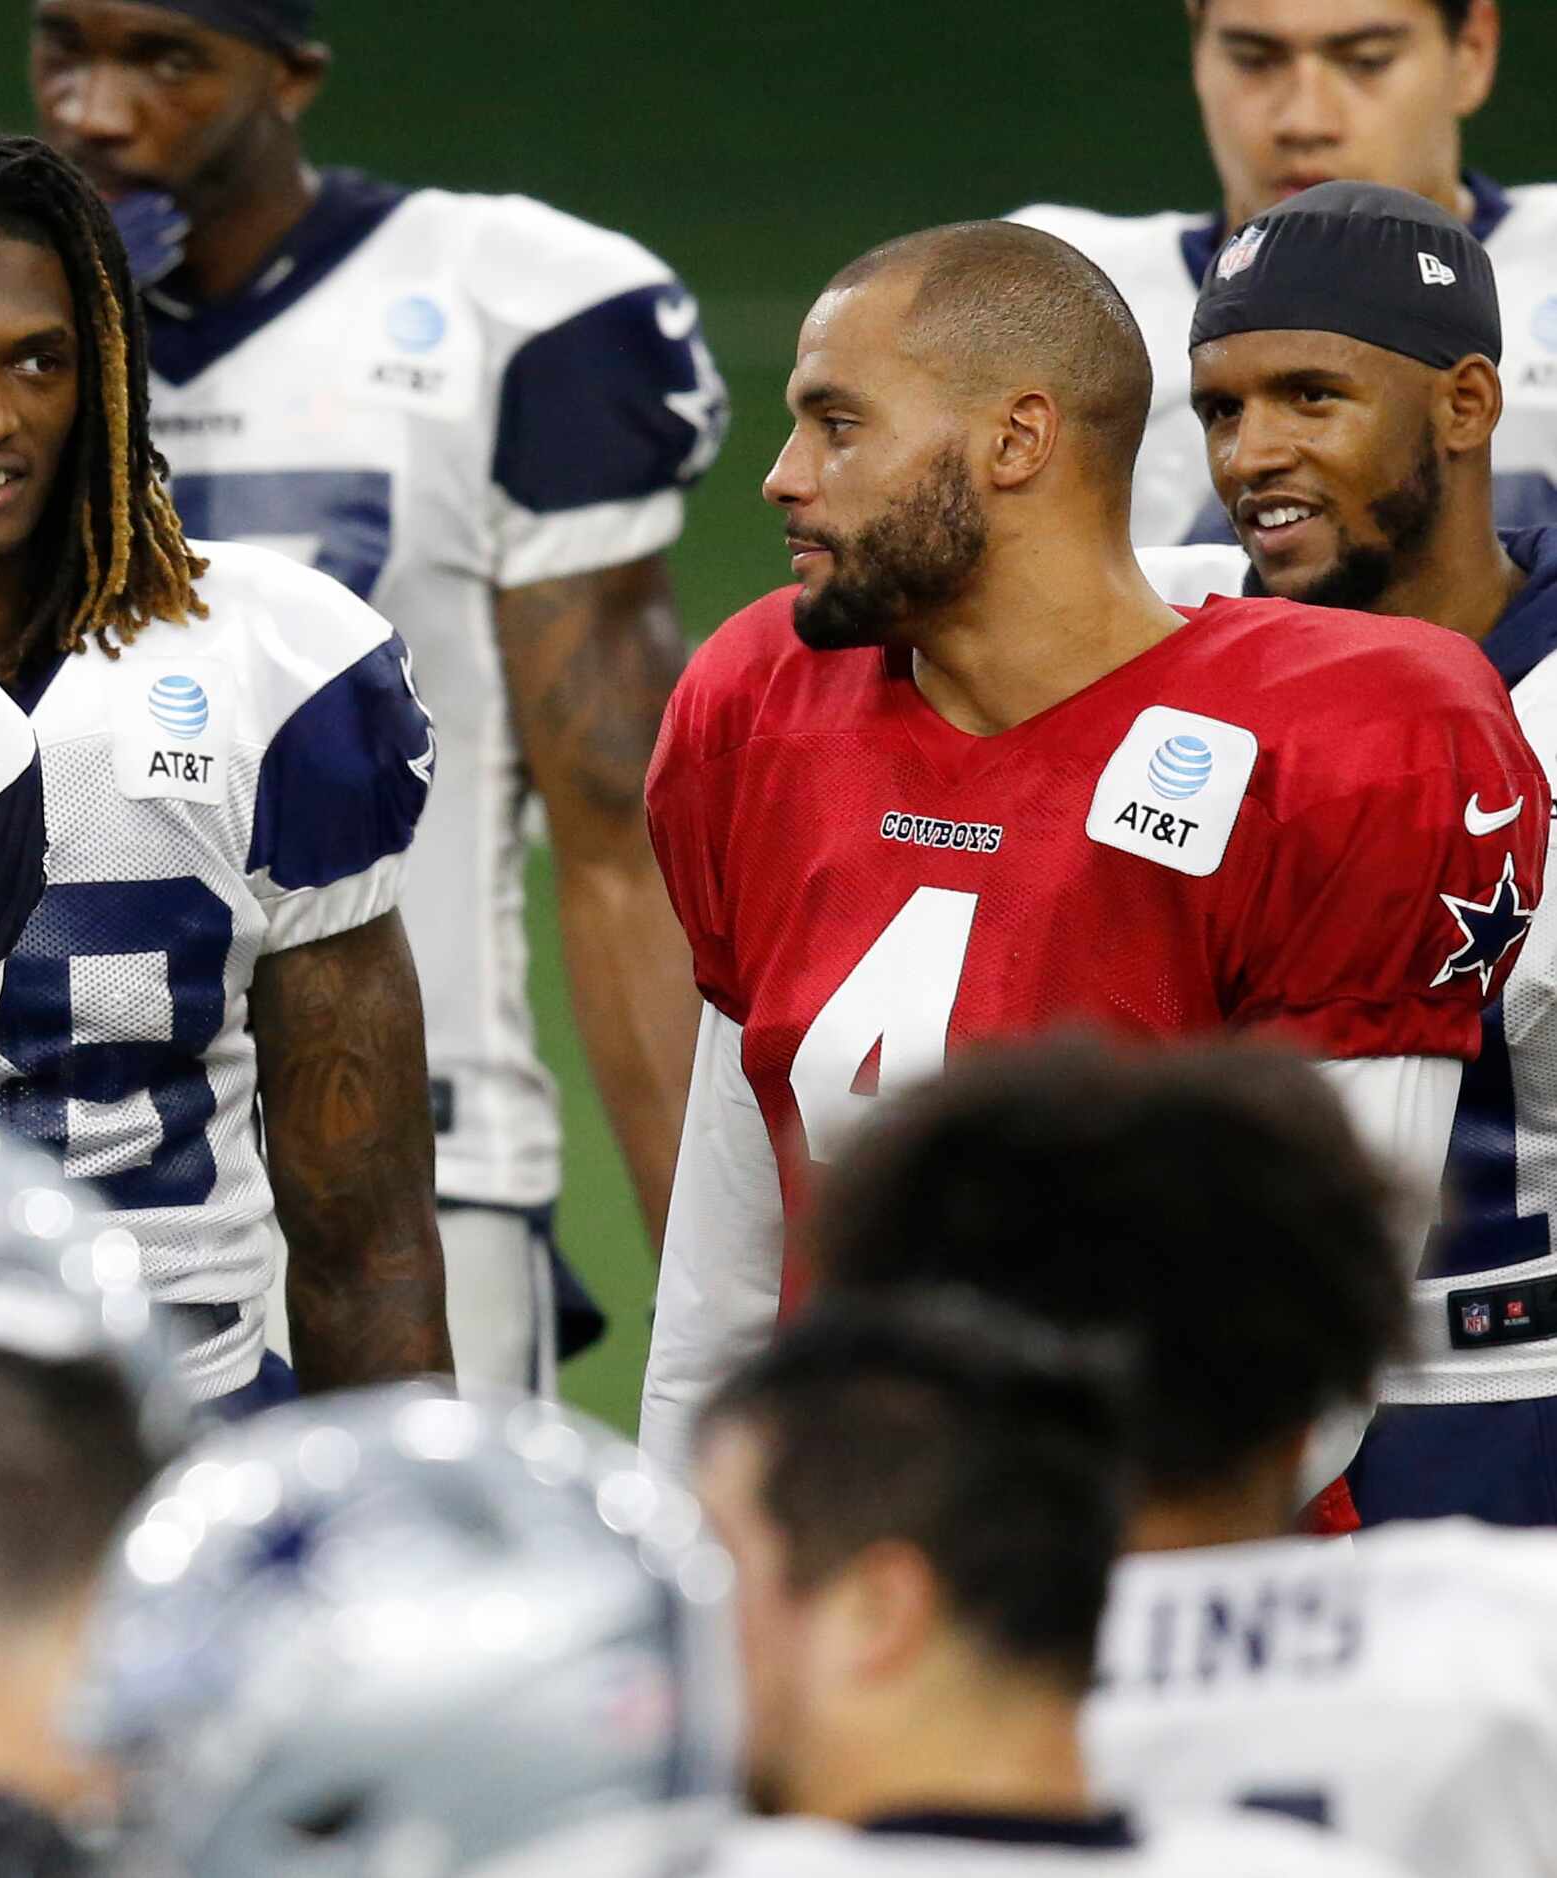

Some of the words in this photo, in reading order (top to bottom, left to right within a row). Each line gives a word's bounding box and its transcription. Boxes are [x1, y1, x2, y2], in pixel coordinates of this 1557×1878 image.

[148, 750, 215, 784] AT&T
[880, 811, 1003, 853] COWBOYS
[1114, 801, 1199, 849] AT&T
